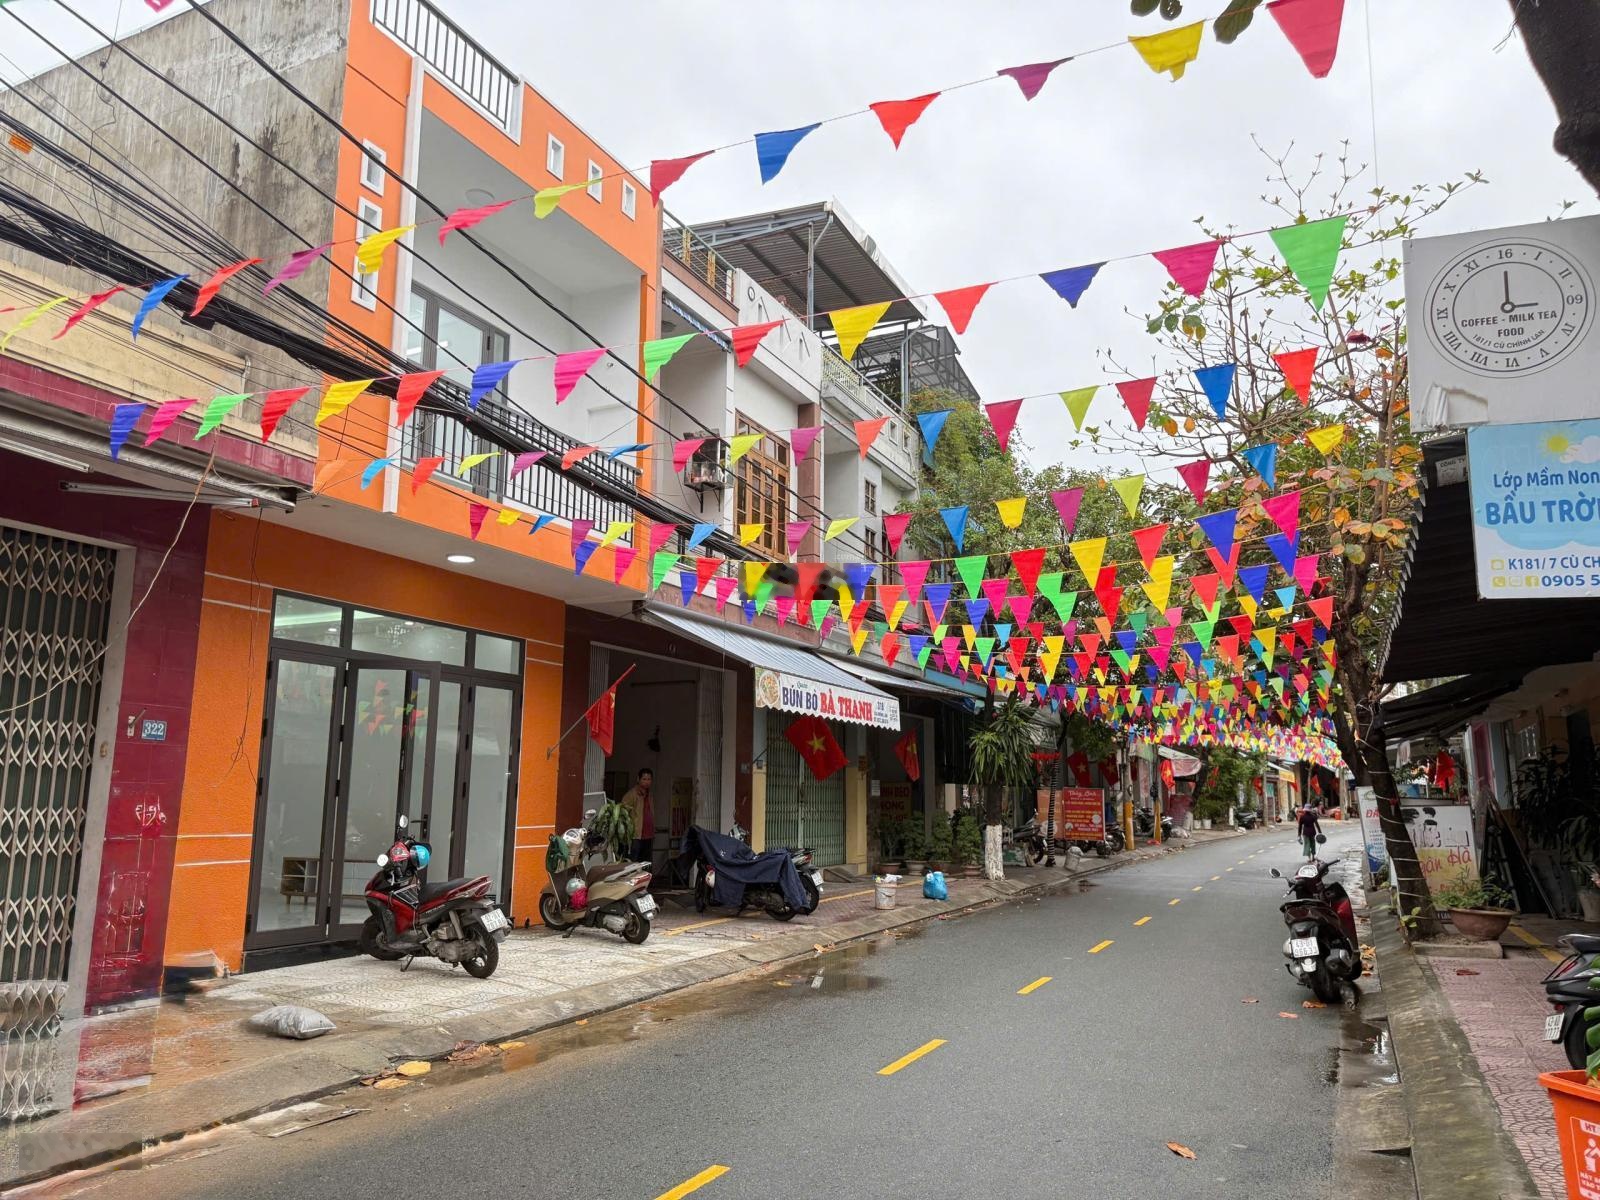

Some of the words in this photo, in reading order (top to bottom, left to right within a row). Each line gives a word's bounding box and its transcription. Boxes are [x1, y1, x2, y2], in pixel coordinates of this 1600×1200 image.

[1498, 249, 1513, 259] 16
[1463, 259, 1480, 273] XI
[1558, 267, 1573, 280] II
[1566, 294, 1584, 305] 09
[1461, 316, 1498, 328] COFFEE
[1509, 312, 1534, 323] MILK
[1537, 310, 1557, 320] TEA
[1497, 327, 1524, 337] FOOD
[1531, 329, 1545, 341] LAN
[1469, 351, 1488, 366] VII
[1505, 357, 1520, 368] VI
[1493, 471, 1522, 491] Lớp
[1527, 467, 1564, 486] Mầm
[1568, 470, 1600, 485] Non
[1485, 490, 1536, 525] BẦU
[1560, 554, 1579, 569] CÙ
[1541, 574, 1585, 587] 0905
[782, 685, 803, 708] BÚN
[806, 688, 818, 711] BÒ
[820, 688, 836, 715] BÀ
[838, 696, 872, 721] THANH
[145, 721, 165, 735] 322
[1420, 857, 1441, 875] gân
